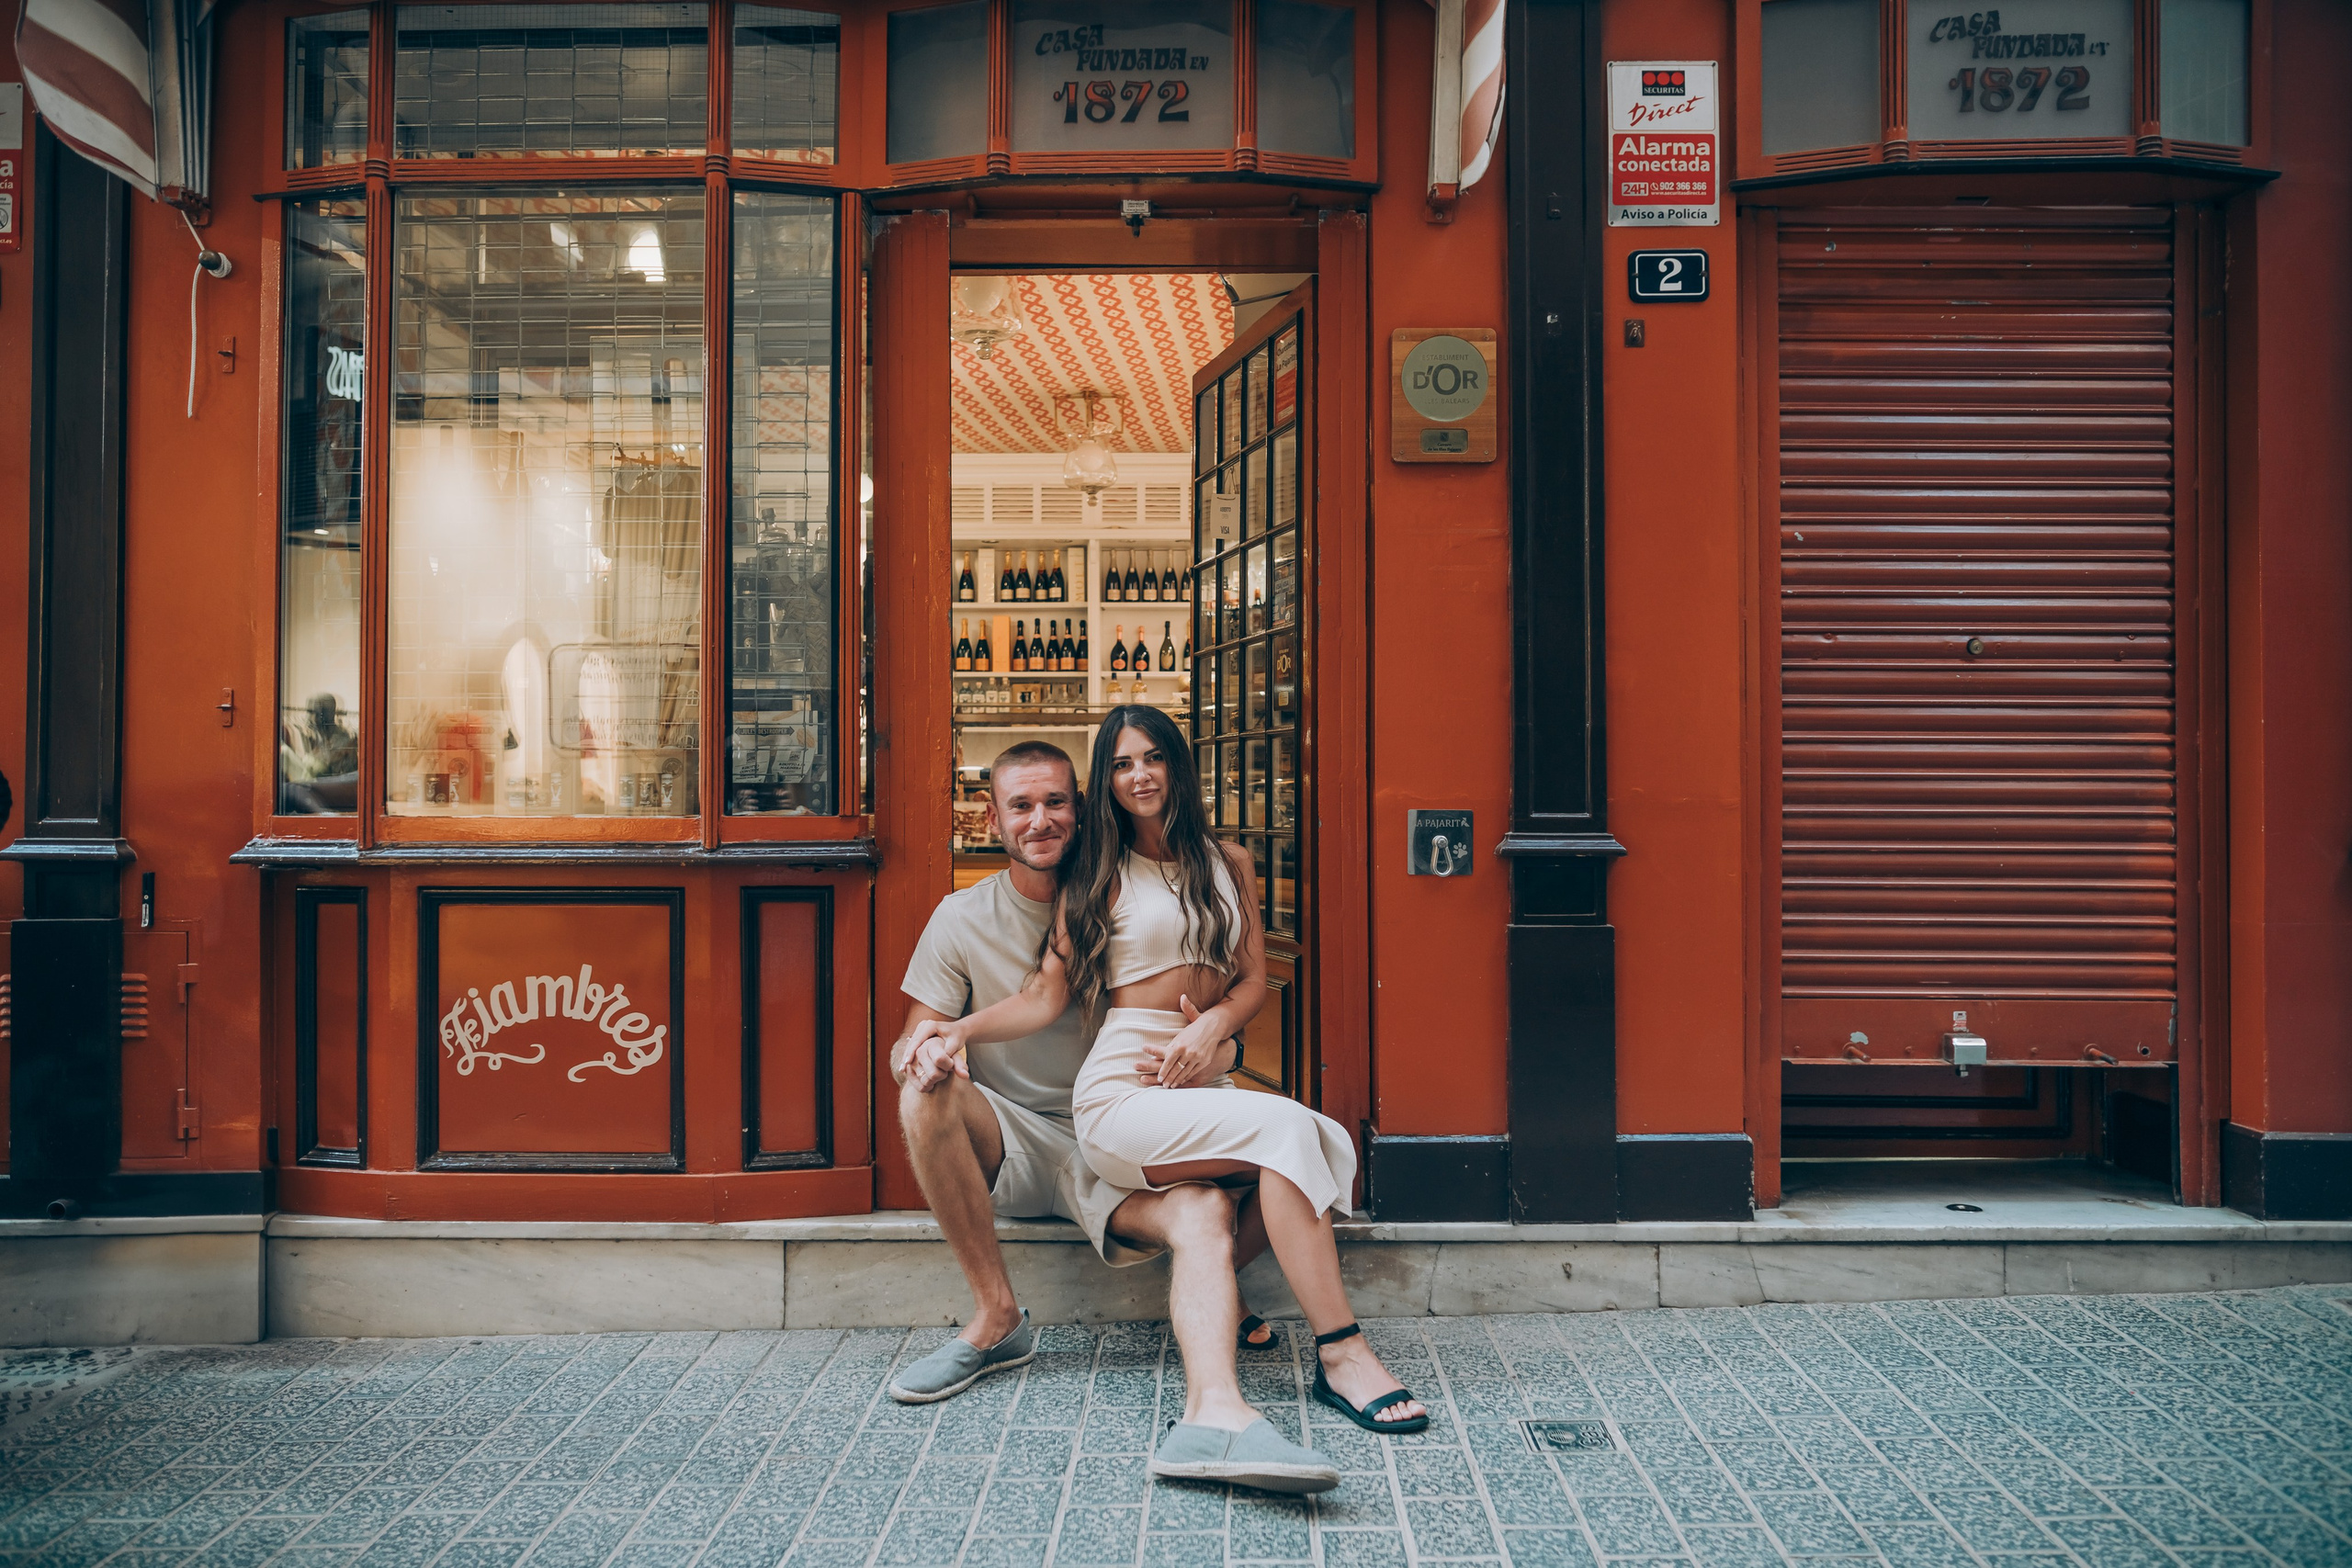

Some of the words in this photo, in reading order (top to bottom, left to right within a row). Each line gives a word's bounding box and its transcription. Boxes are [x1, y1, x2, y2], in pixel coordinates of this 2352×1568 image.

[1035, 24, 1104, 56] CASA
[1929, 9, 2001, 43] CASA
[1076, 48, 1187, 72] FUNDADA
[1189, 56, 1209, 71] EN
[1972, 33, 2086, 59] FUNDADA
[1053, 80, 1190, 124] 1872
[1948, 65, 2090, 113] 1872
[1627, 96, 1706, 127] Direct
[1618, 136, 1711, 156] Alarma
[1618, 156, 1711, 172] conectada
[1623, 184, 1647, 195] 24H
[1659, 182, 1674, 191] 902
[1676, 182, 1690, 191] 366
[1692, 182, 1707, 191] 366
[1621, 209, 1655, 220] Aviso
[1657, 211, 1665, 220] a
[1668, 209, 1707, 220] Policía
[1657, 257, 1682, 292] 2
[1413, 363, 1479, 396] D'OR
[439, 964, 667, 1083] Fiambres
